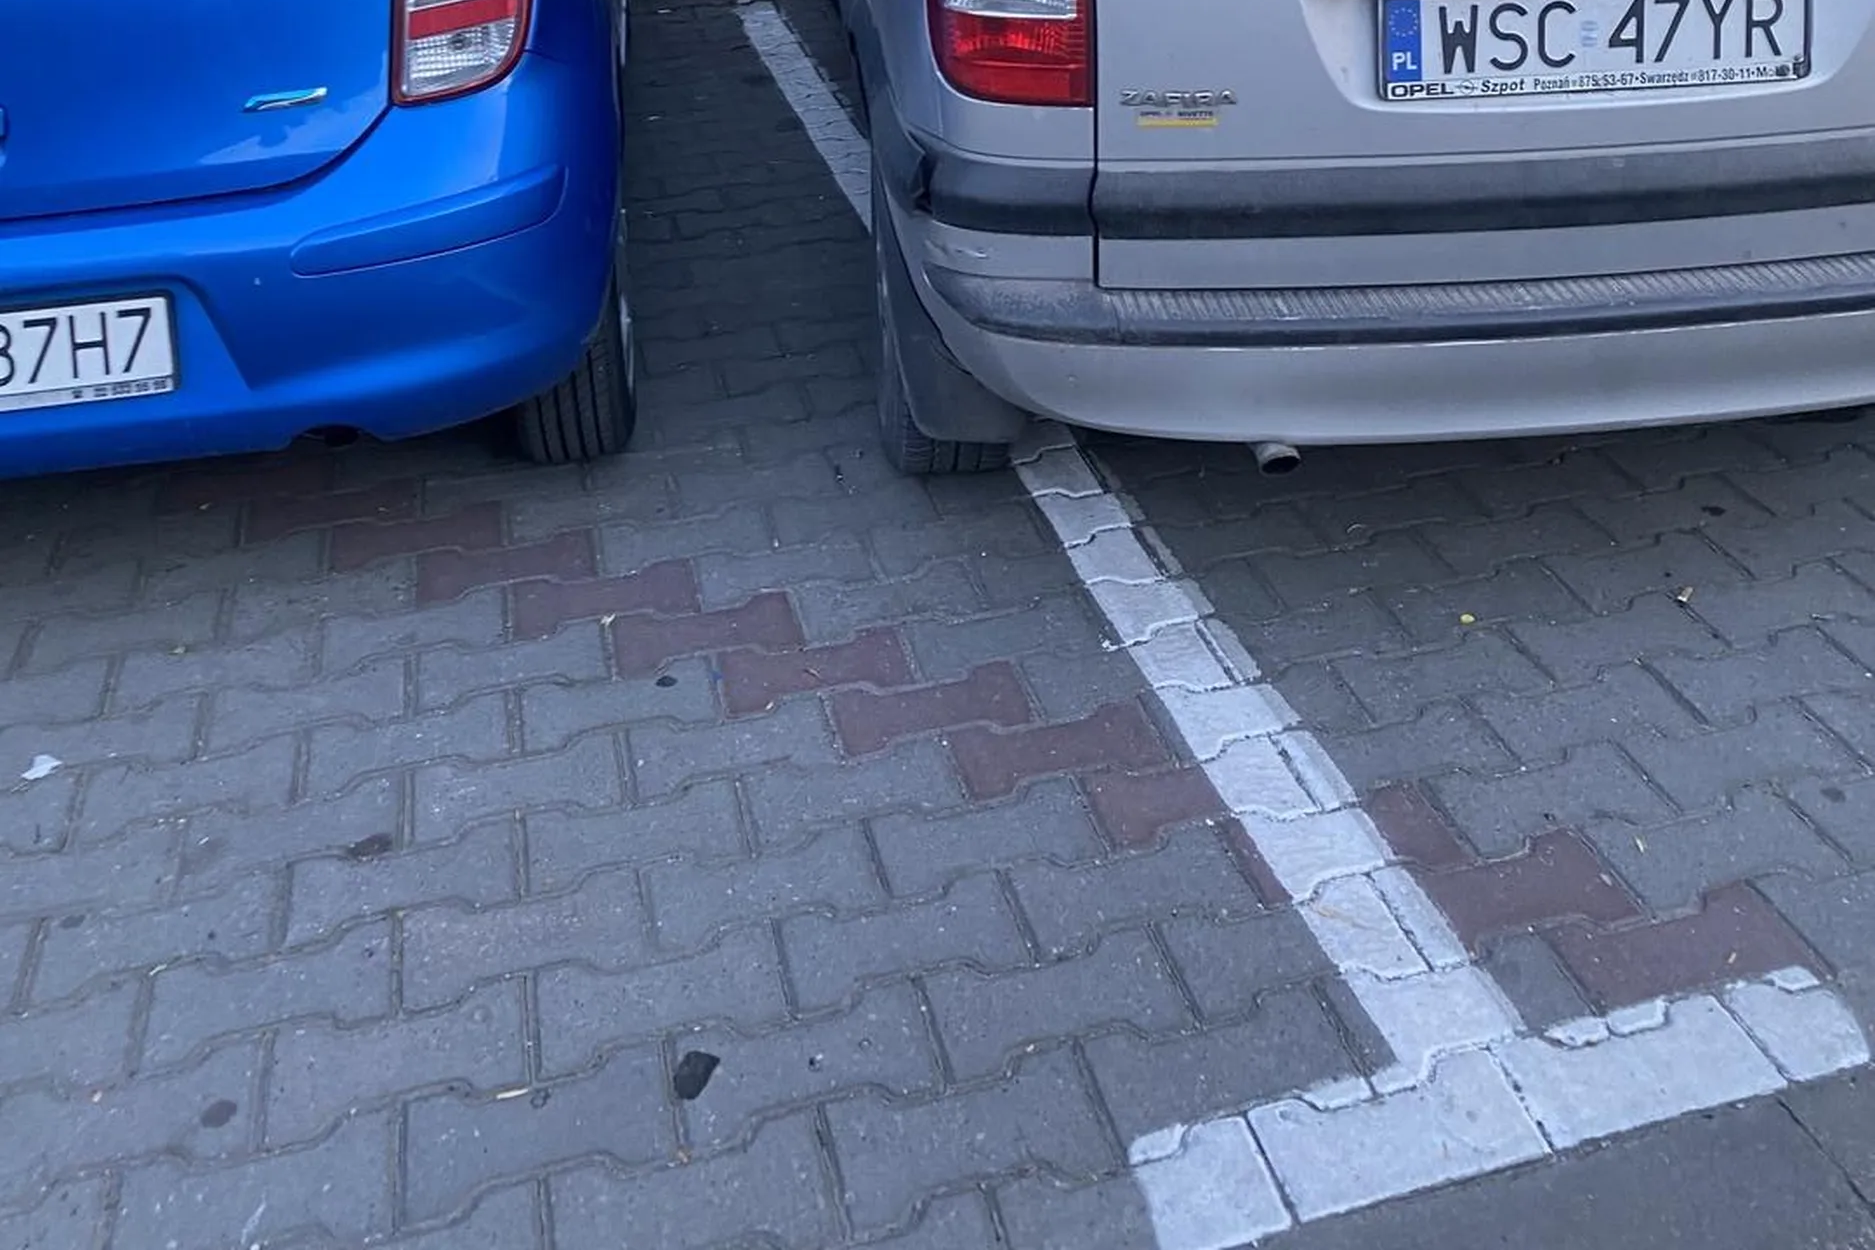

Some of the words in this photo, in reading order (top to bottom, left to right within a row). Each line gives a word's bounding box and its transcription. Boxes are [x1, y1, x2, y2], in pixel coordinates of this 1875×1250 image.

[1439, 0, 1576, 74] WSC
[1392, 53, 1417, 71] PL
[1391, 83, 1454, 97] OPEL
[1481, 78, 1524, 95] Szpot
